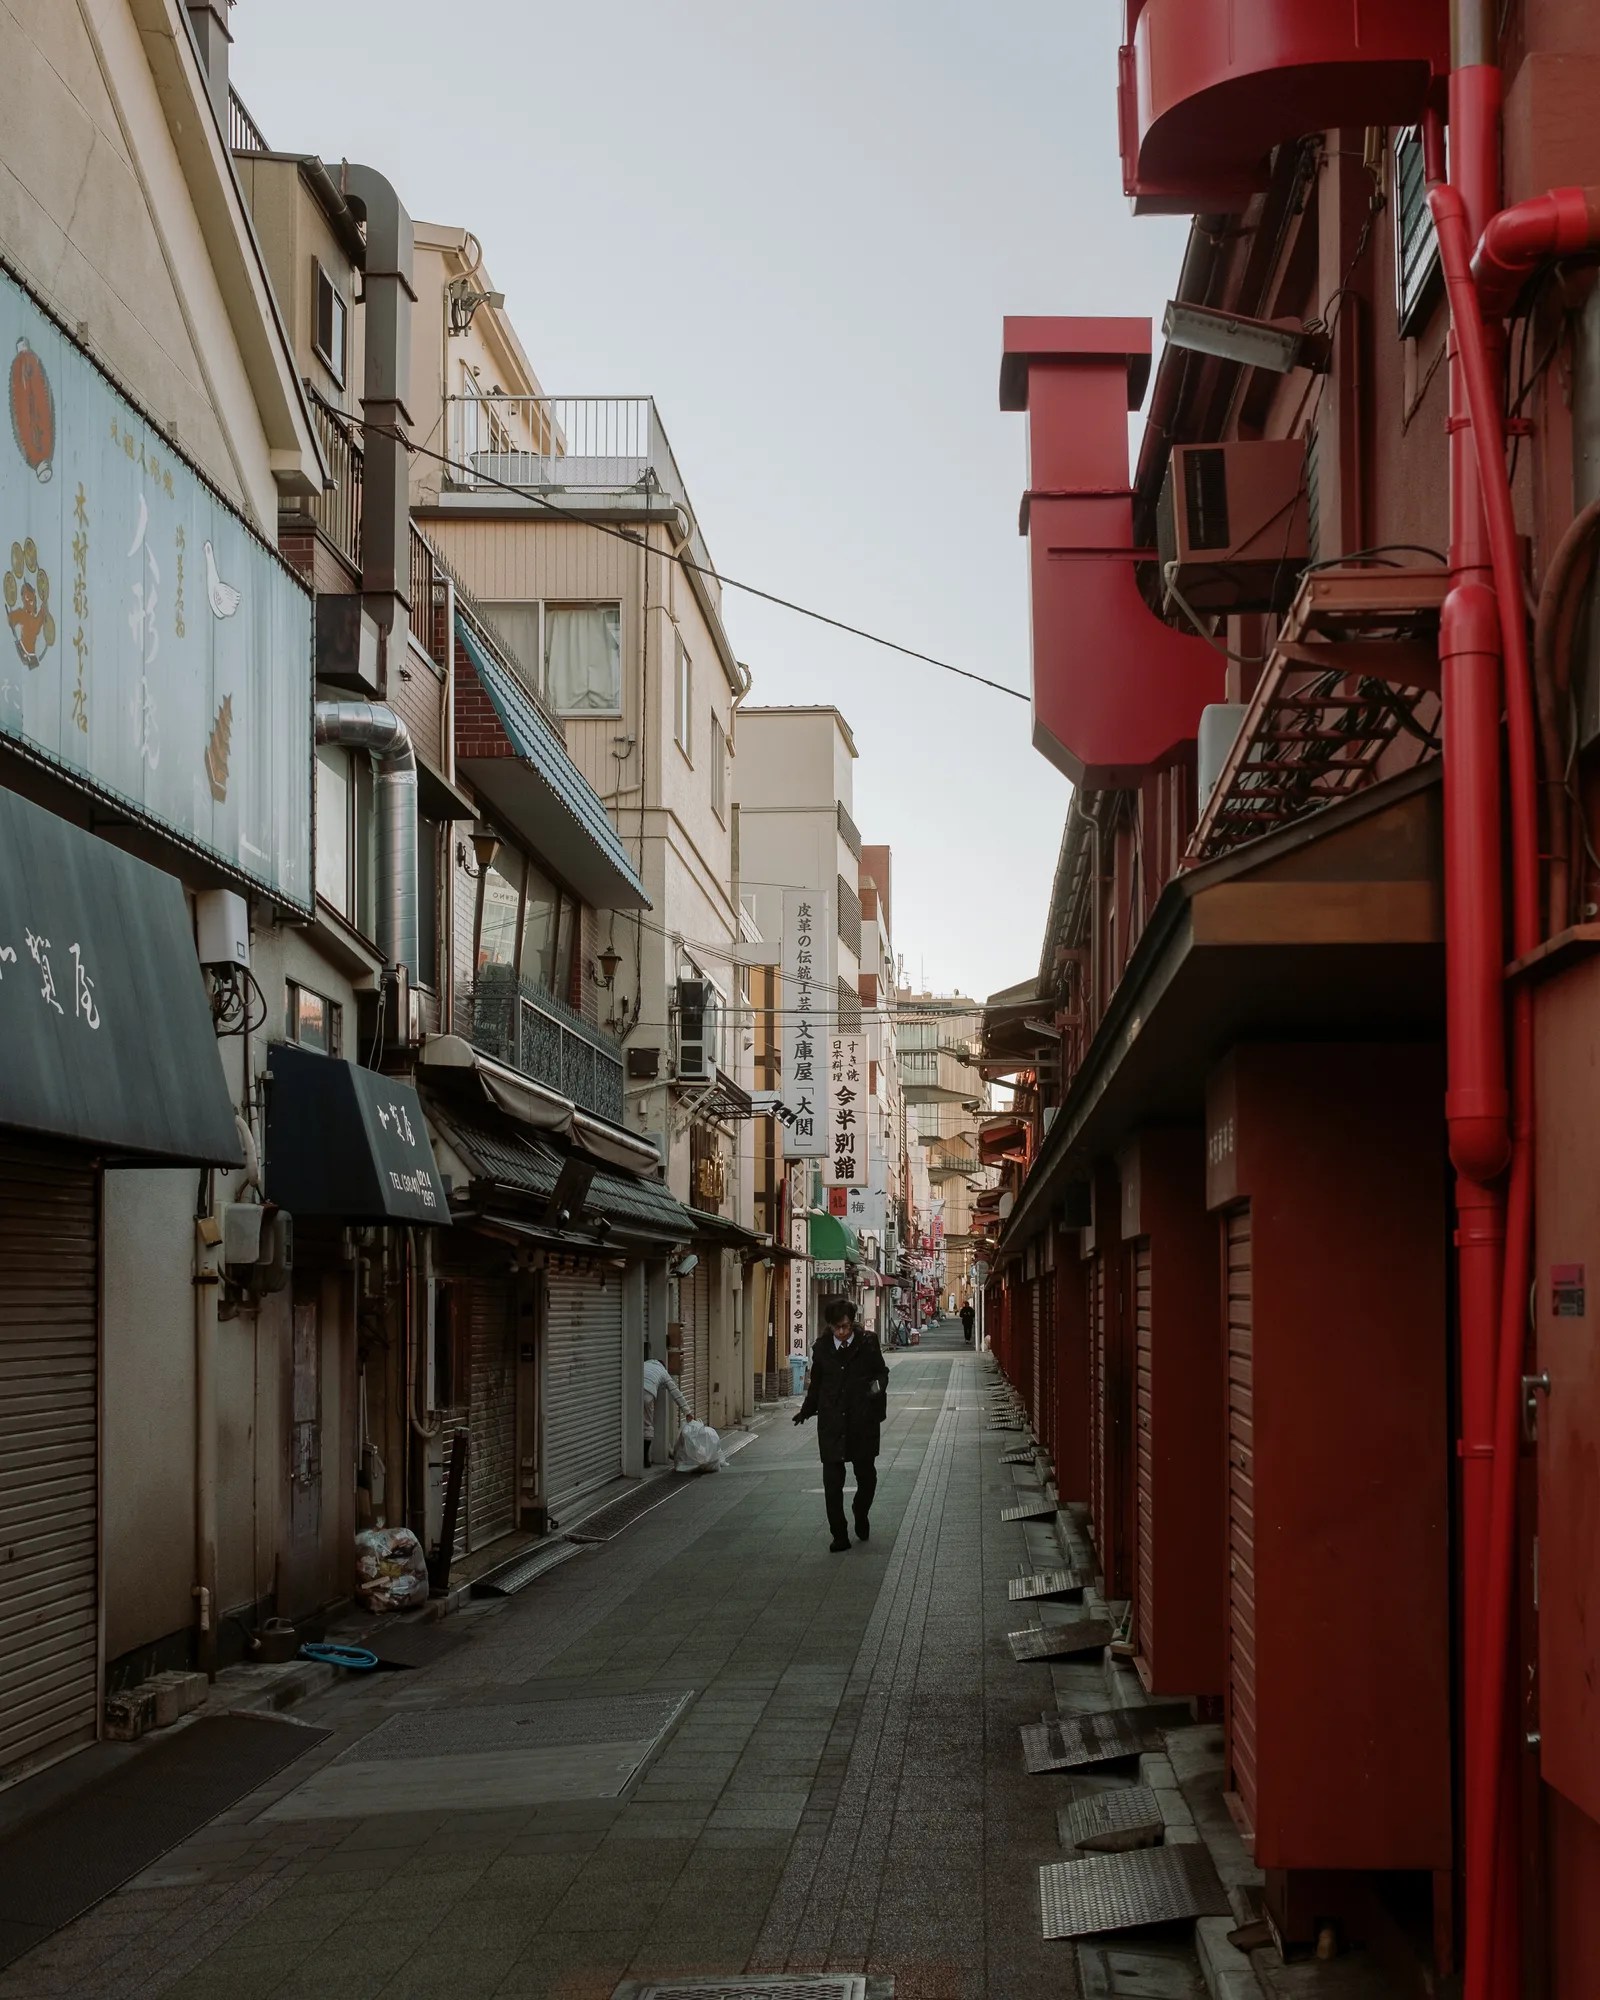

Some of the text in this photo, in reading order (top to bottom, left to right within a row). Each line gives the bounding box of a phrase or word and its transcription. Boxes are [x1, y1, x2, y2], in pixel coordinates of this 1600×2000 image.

[793, 902, 815, 1147] 皮革の伝統工芸 文庫屋「大関」
[832, 1040, 844, 1082] 日本料理
[389, 1171, 403, 1190] TEL
[793, 1309, 804, 1356] 今半別
